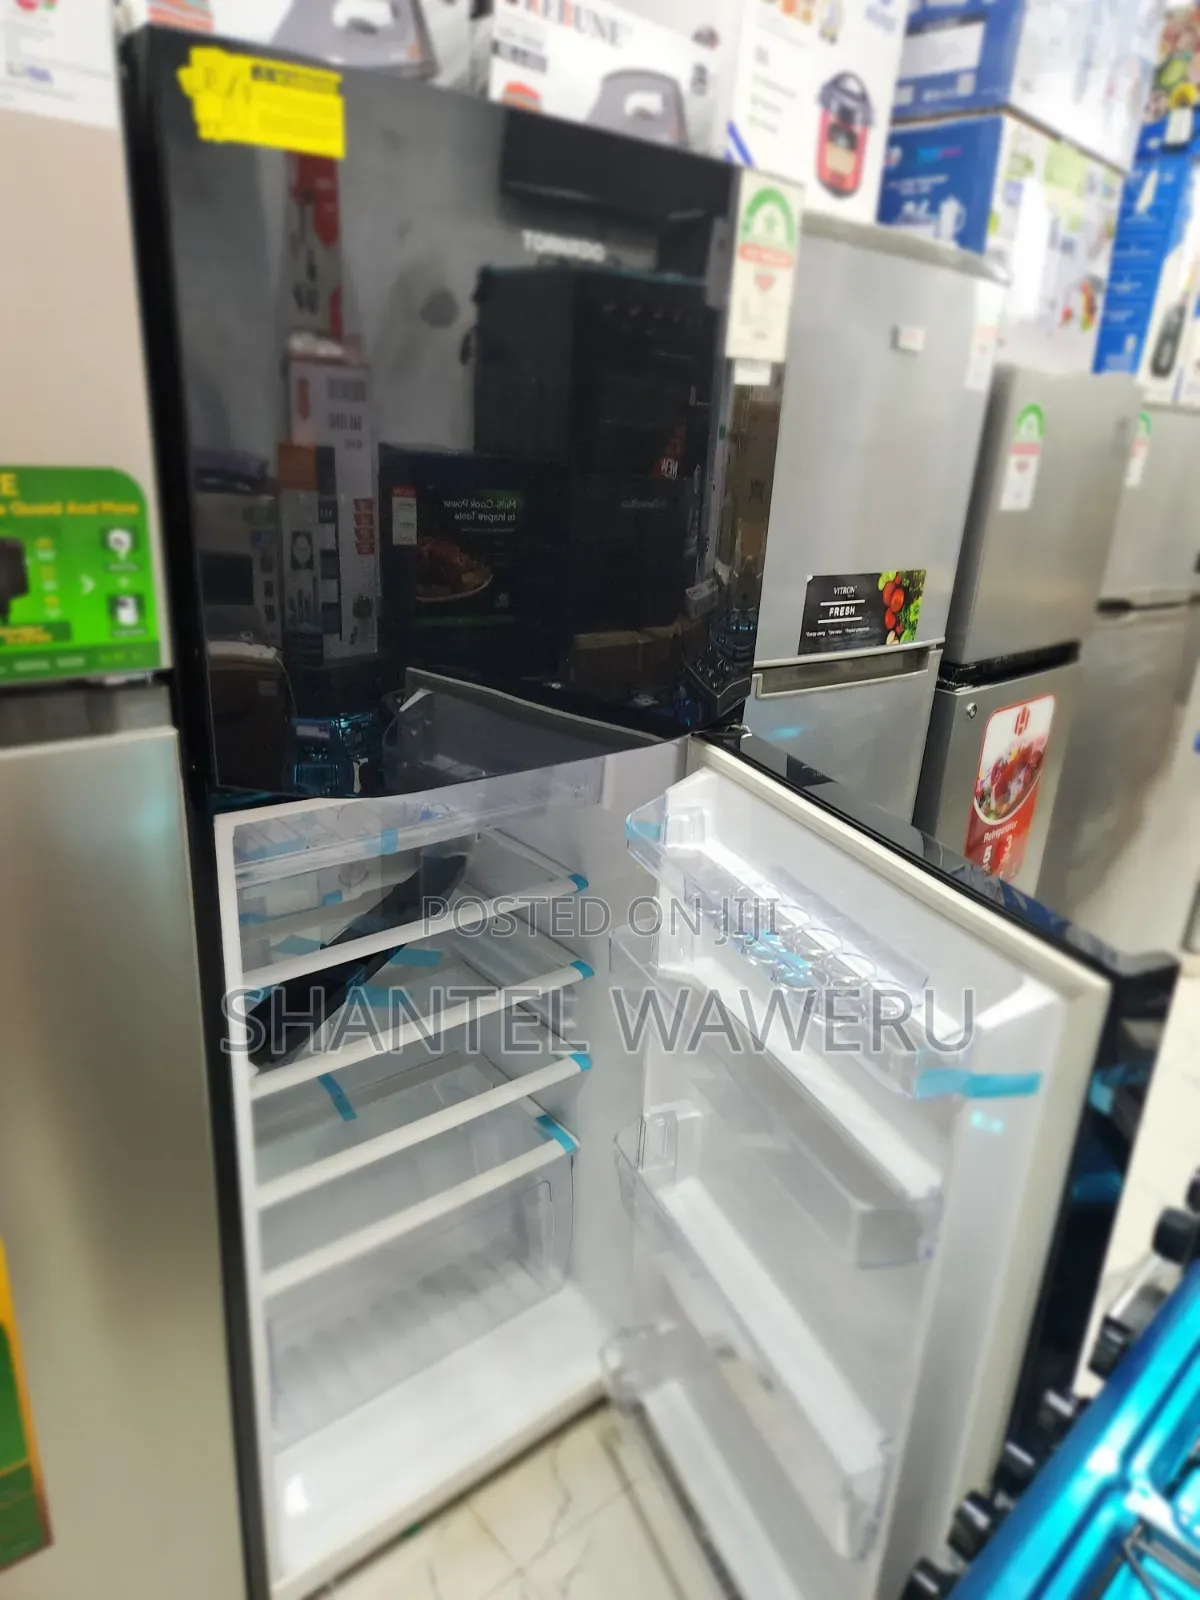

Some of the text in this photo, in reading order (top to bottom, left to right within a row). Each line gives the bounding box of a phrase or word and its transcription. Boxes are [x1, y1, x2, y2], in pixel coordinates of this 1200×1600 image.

[833, 585, 855, 596] VITRON
[828, 606, 856, 617] FRESH
[983, 820, 1018, 844] Refrigerator
